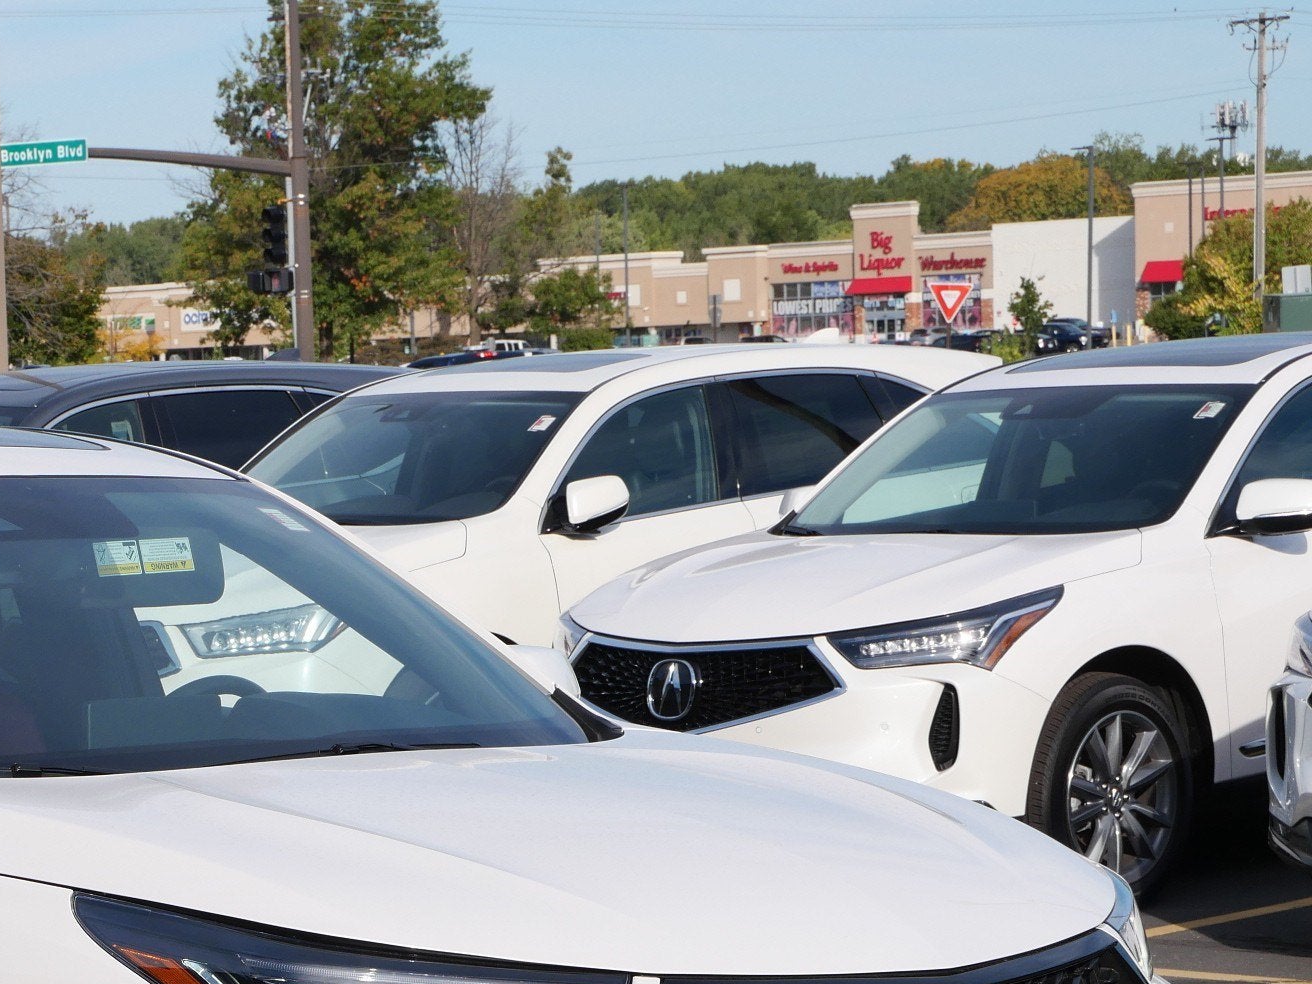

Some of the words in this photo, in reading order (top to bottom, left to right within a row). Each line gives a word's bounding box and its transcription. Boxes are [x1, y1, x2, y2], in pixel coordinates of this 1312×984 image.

[0, 148, 53, 163] Brooklyn
[57, 144, 83, 158] Blvd
[870, 231, 893, 254] Big
[859, 253, 905, 276] Liquor
[919, 252, 987, 271] Warehouse
[773, 300, 813, 316] LOWEST
